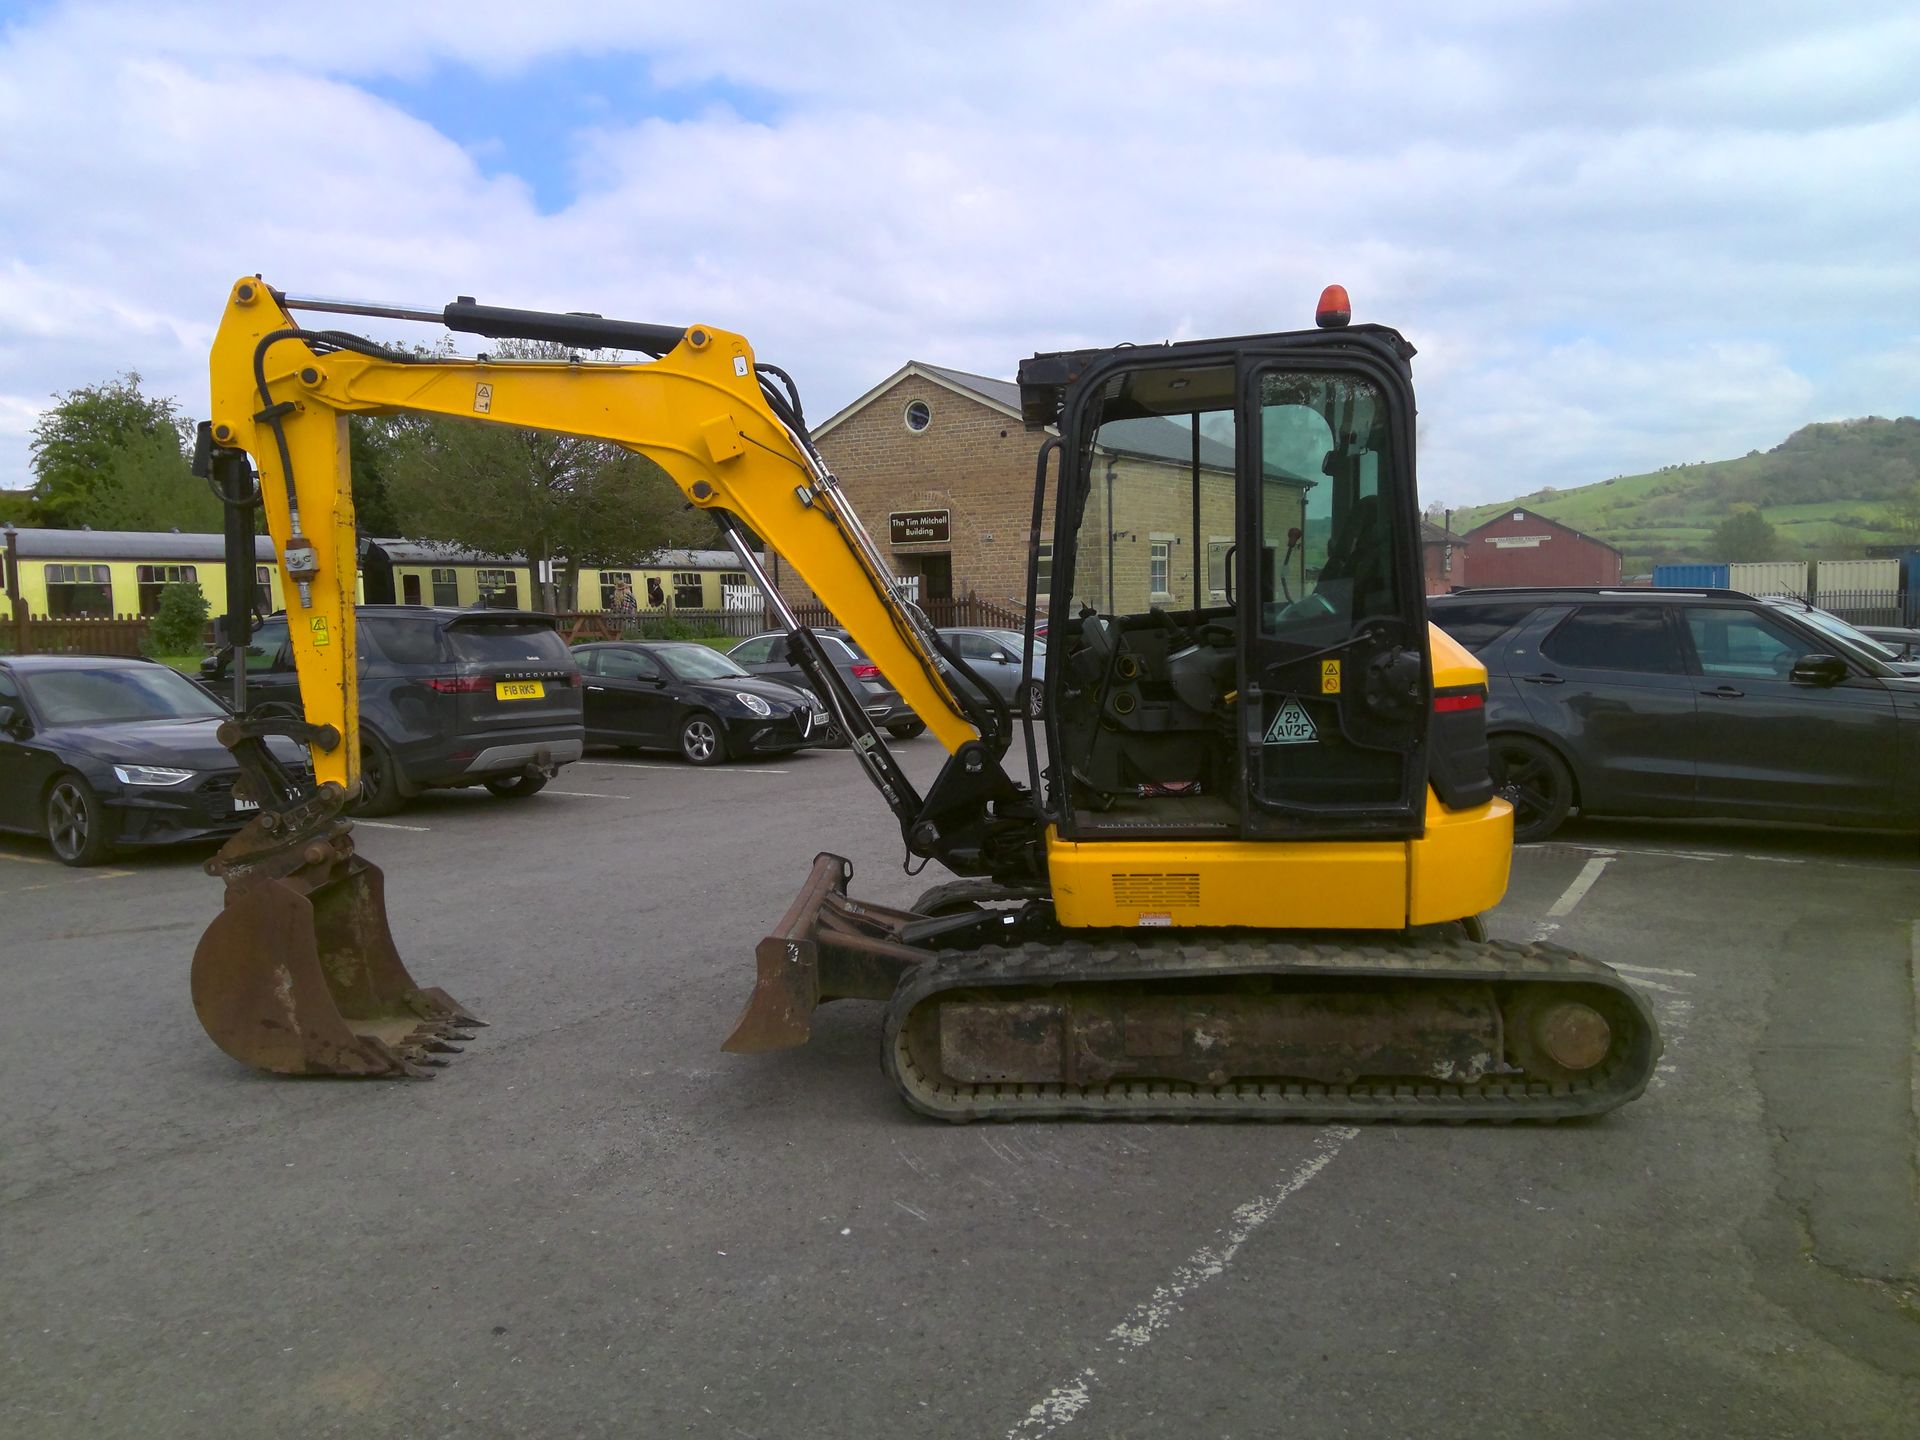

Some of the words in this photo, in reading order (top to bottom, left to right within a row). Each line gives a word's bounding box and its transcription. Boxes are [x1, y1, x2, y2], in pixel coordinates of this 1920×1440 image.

[892, 519, 904, 527] The
[906, 517, 919, 526] Tim
[920, 515, 947, 525] Mitchell
[905, 527, 934, 536] Building
[505, 671, 565, 679] DISCOVERY
[520, 684, 536, 695] RKS
[1285, 711, 1300, 723] 29
[1277, 724, 1310, 737] AV2F
